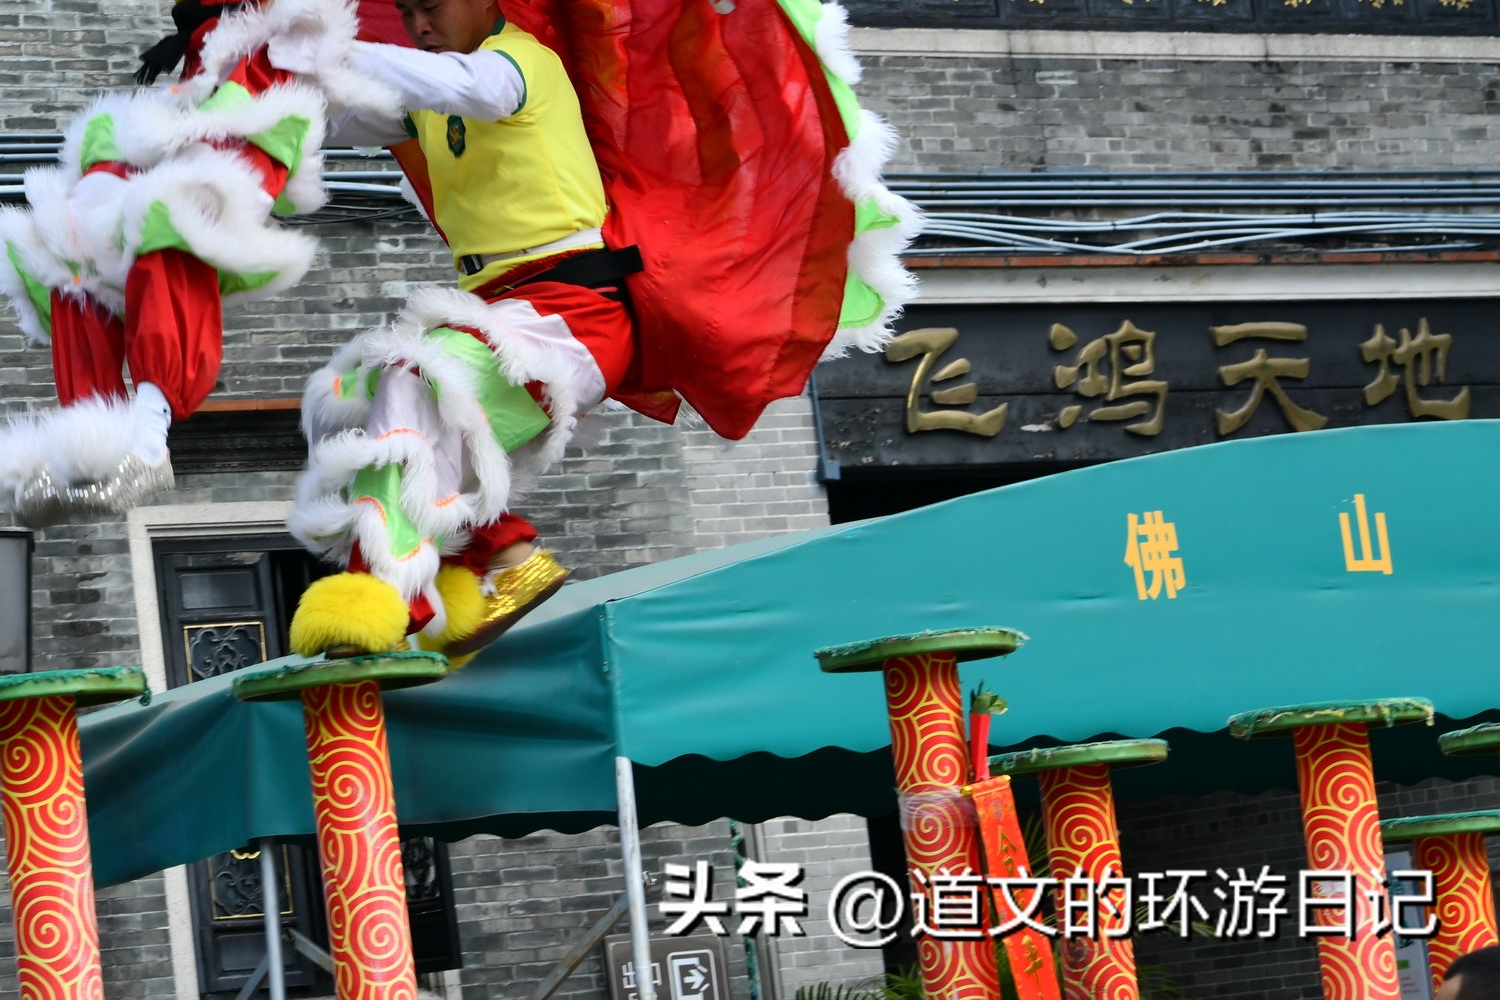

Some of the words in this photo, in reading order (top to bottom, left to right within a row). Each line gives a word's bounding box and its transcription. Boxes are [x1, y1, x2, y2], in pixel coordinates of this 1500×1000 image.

[885, 317, 1470, 438] 飞鸿天地
[1123, 493, 1394, 601] 佛山
